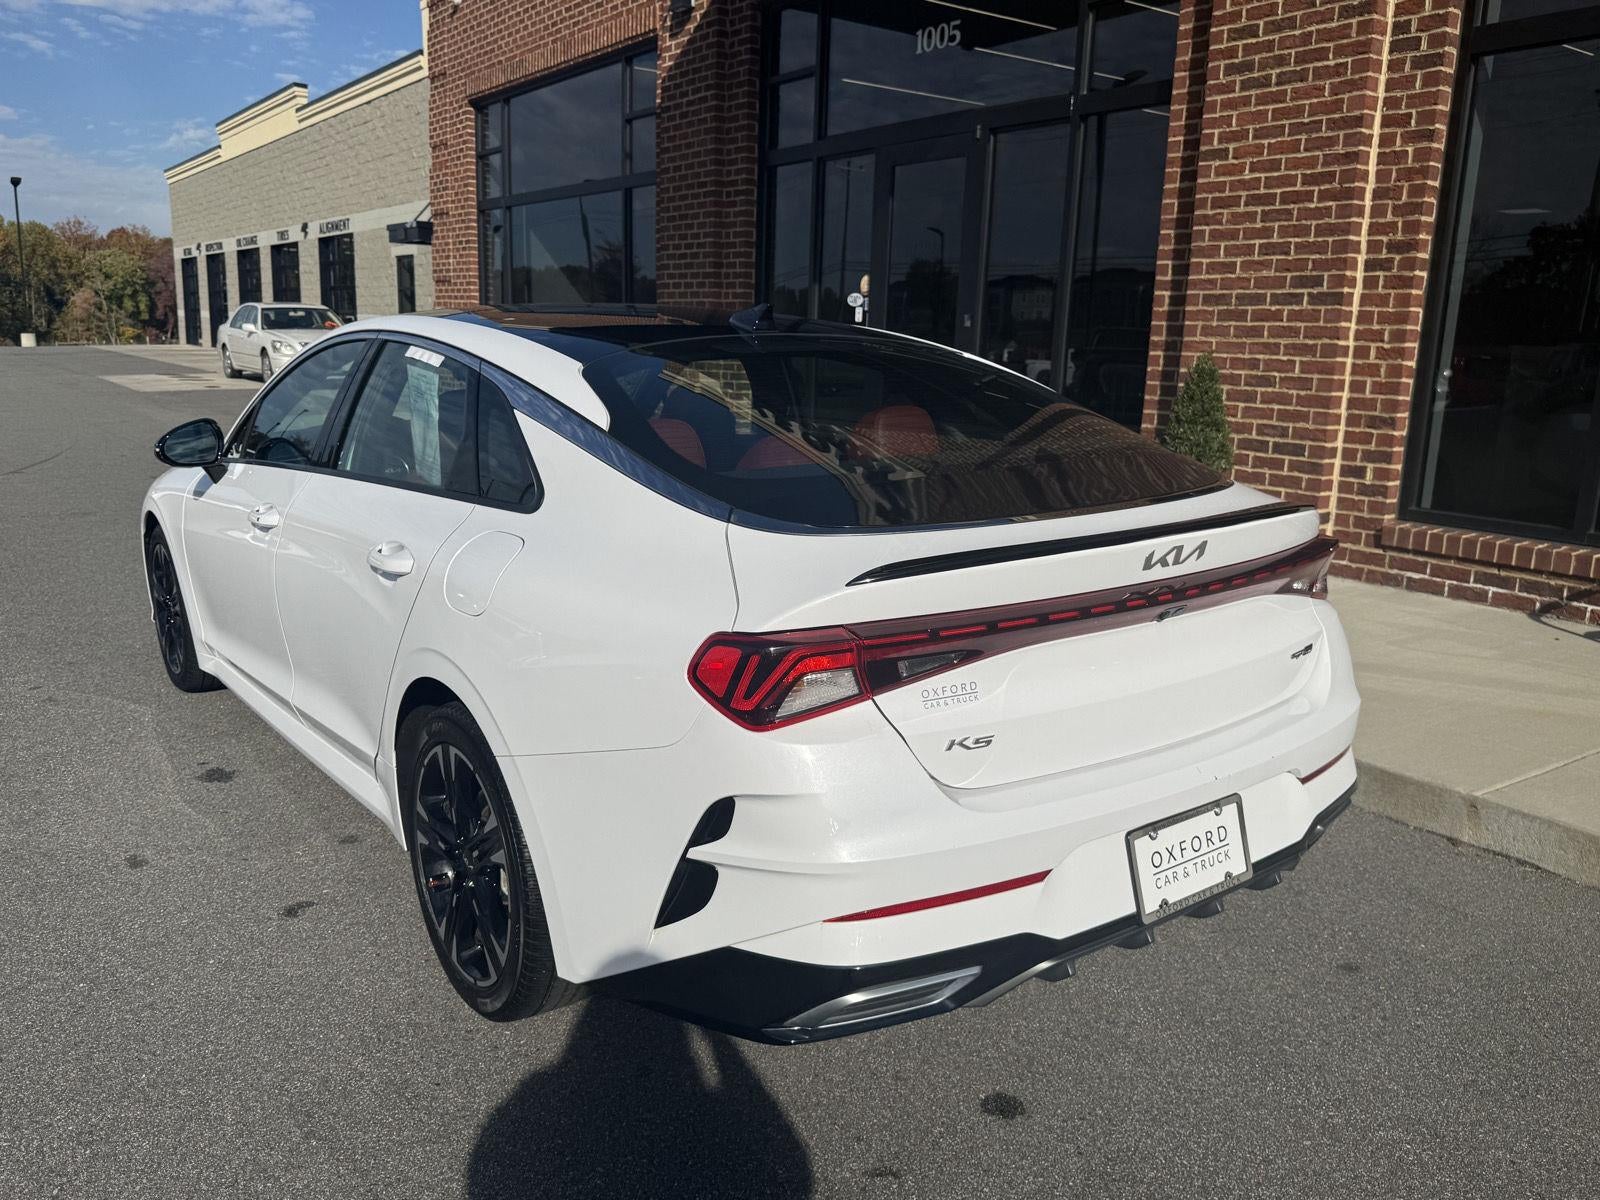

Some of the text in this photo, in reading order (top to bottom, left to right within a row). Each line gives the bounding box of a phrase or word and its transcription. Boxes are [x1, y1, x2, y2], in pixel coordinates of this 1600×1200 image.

[915, 19, 962, 55] 1005
[276, 229, 290, 242] TIRES
[319, 218, 350, 235] ALIGNMENT
[1142, 539, 1208, 572] KIA
[921, 681, 978, 699] OXFORD
[923, 700, 942, 710] CAR
[951, 694, 980, 705] TRUCK
[944, 734, 996, 752] K5
[1150, 825, 1228, 869] OXFORD
[1154, 848, 1232, 890] CAR & TRUCK
[1155, 898, 1190, 919] OXFORD
